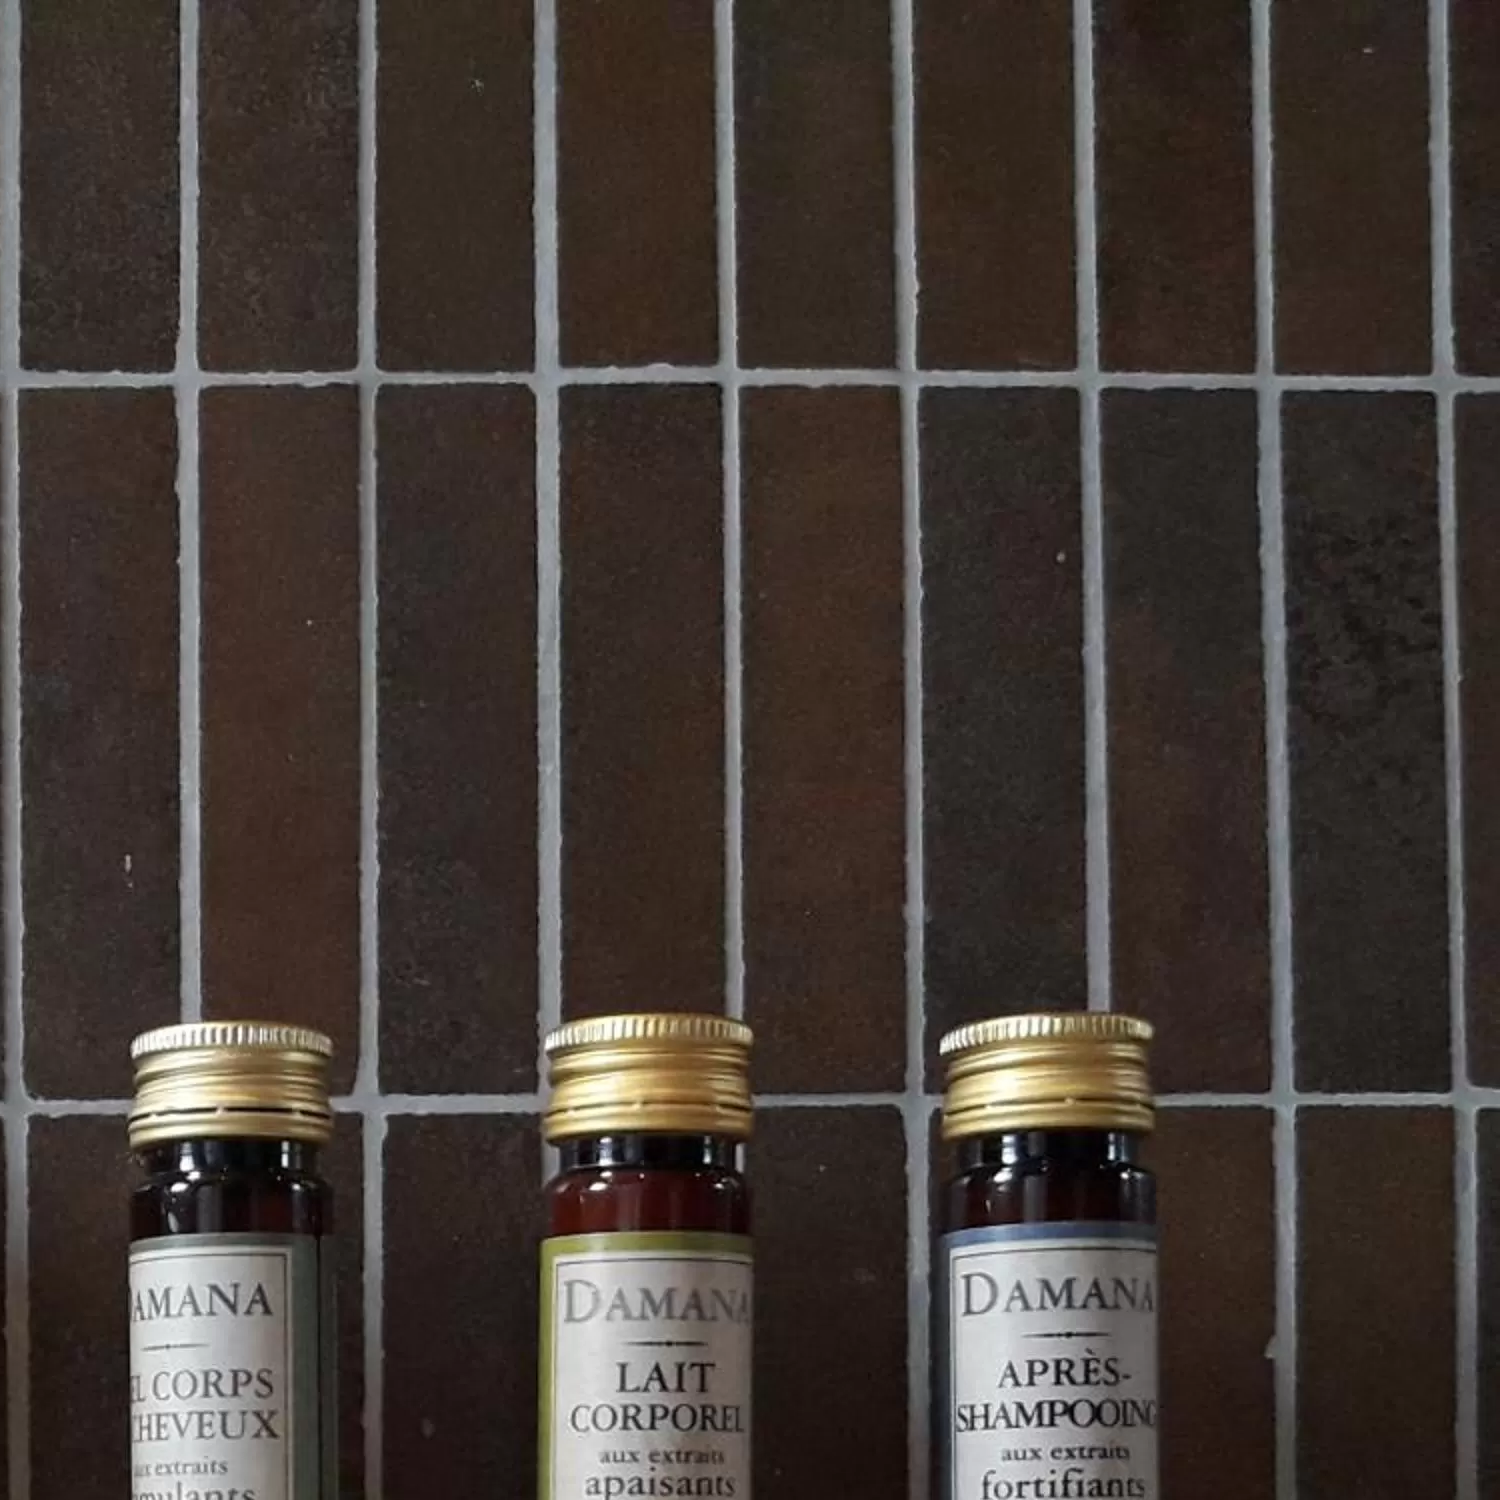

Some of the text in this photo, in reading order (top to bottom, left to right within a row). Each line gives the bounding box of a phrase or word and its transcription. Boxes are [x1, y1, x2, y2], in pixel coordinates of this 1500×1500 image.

[132, 1282, 273, 1322] AMANA
[616, 1362, 716, 1393] LAIT
[998, 1348, 1132, 1388] APRÈS-
[152, 1368, 274, 1400] CORPS
[132, 1410, 280, 1443] HEVEUX
[570, 1403, 744, 1432] CORPOREL
[155, 1456, 229, 1476] extraits
[600, 1450, 640, 1465] aux
[1002, 1445, 1129, 1461] aux extraits
[981, 1468, 1145, 1500] fortifiants
